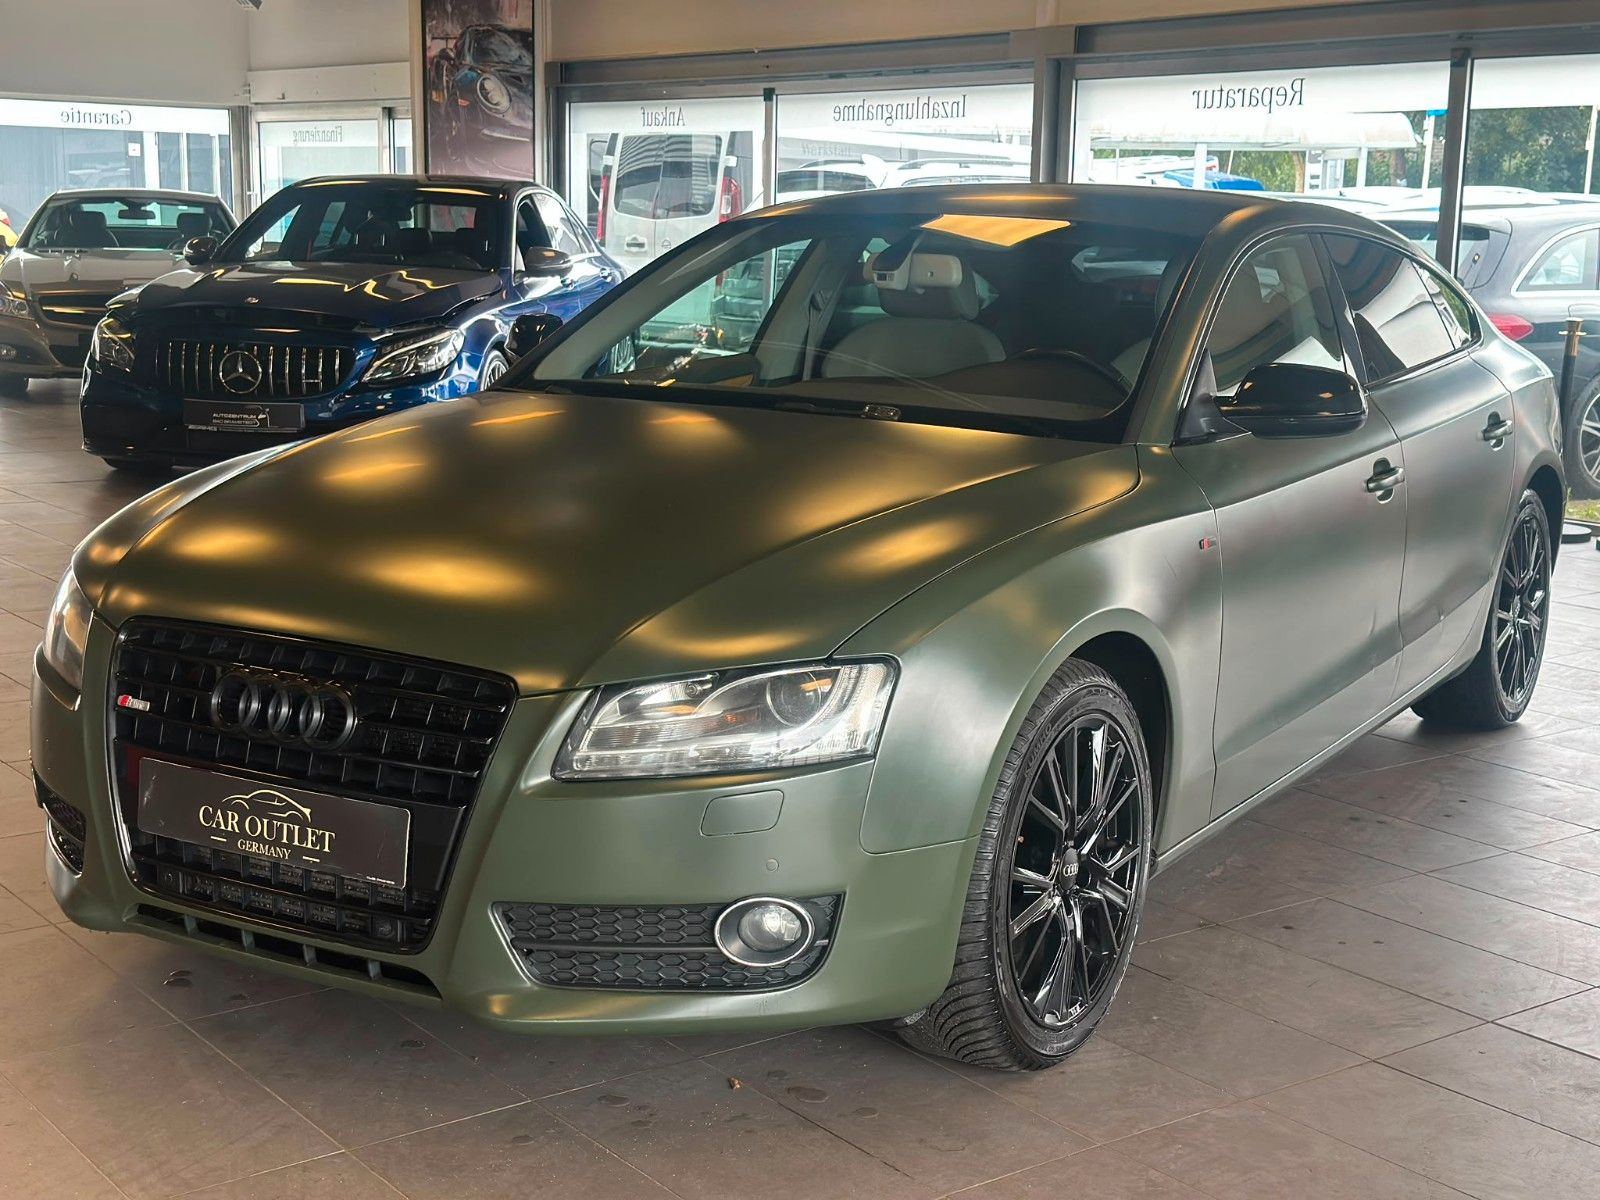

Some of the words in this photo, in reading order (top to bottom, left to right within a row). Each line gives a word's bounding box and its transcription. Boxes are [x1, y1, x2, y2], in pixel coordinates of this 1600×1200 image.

[199, 805, 240, 833] CAR
[245, 815, 336, 853] OUTLET
[237, 838, 291, 860] GERMANY
